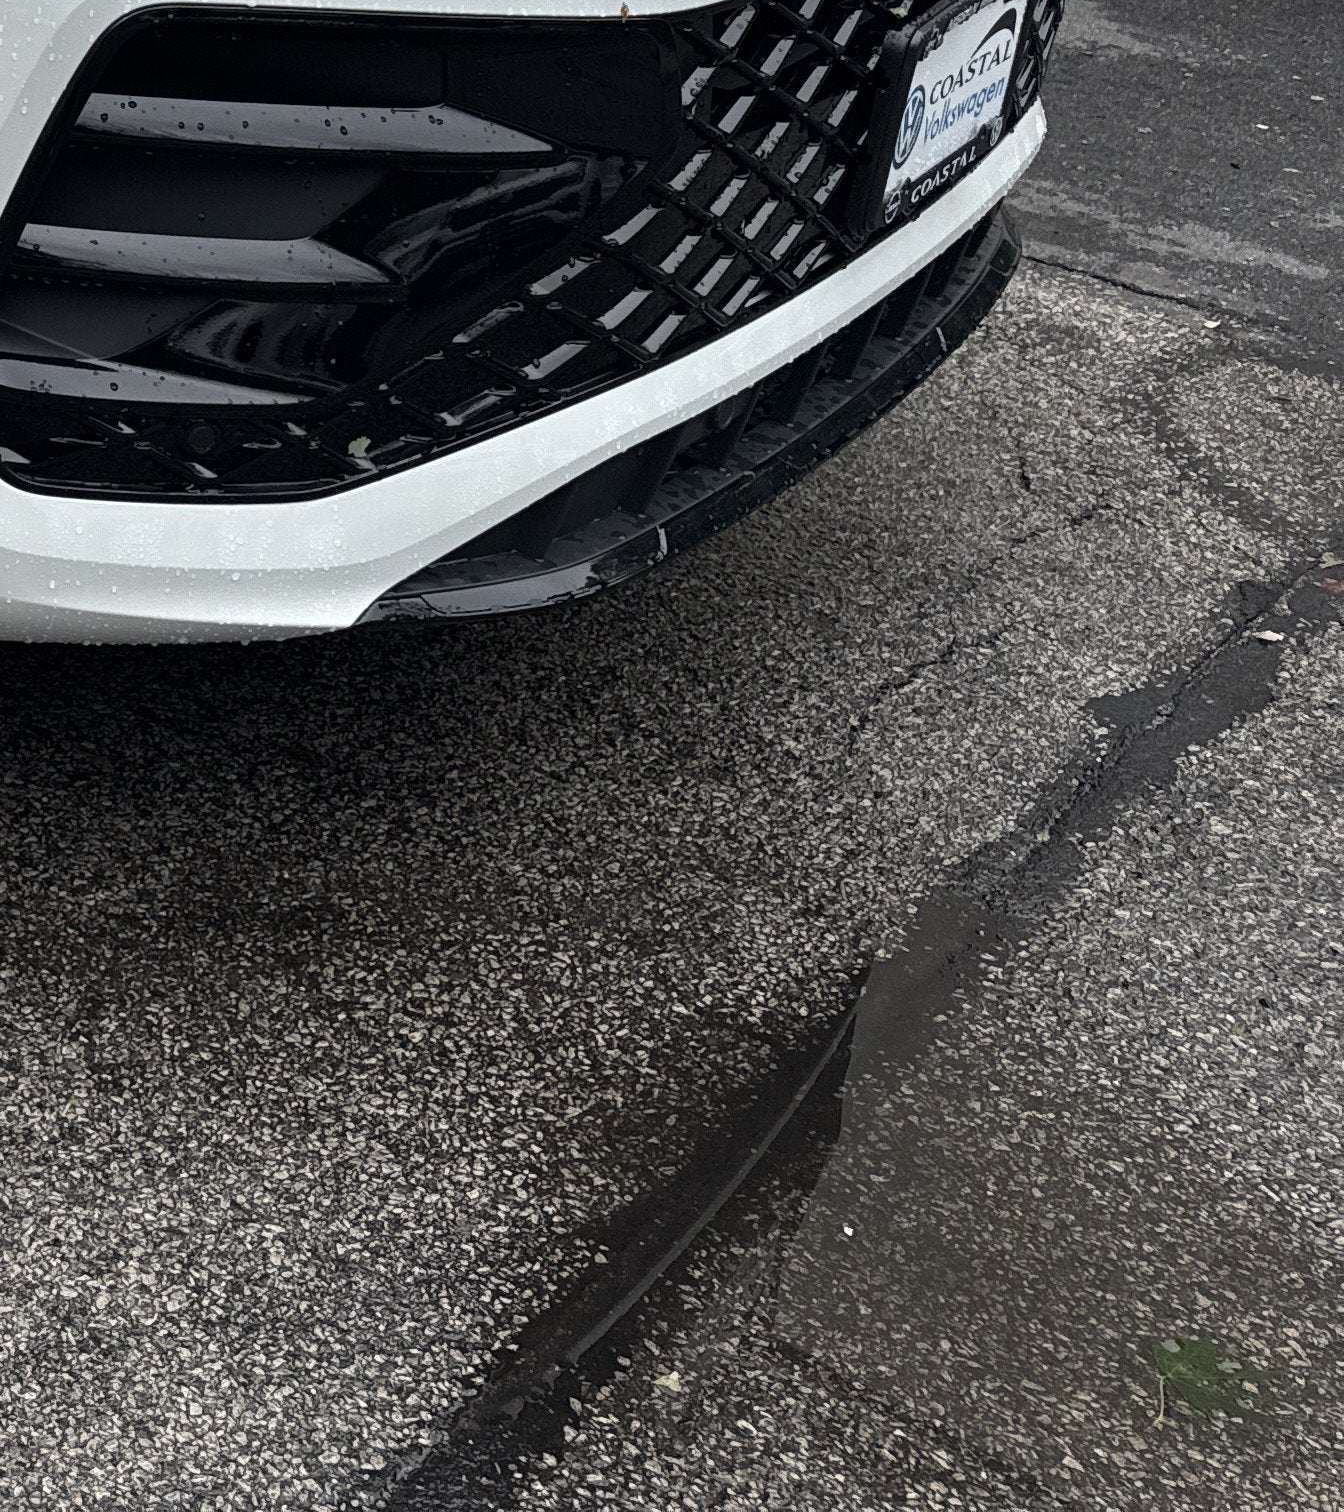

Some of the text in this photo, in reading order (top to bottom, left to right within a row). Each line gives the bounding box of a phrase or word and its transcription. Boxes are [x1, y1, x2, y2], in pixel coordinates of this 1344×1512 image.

[929, 39, 1012, 105] COASTAL
[923, 76, 1006, 145] Volkswagen
[910, 145, 977, 203] COASTAL
